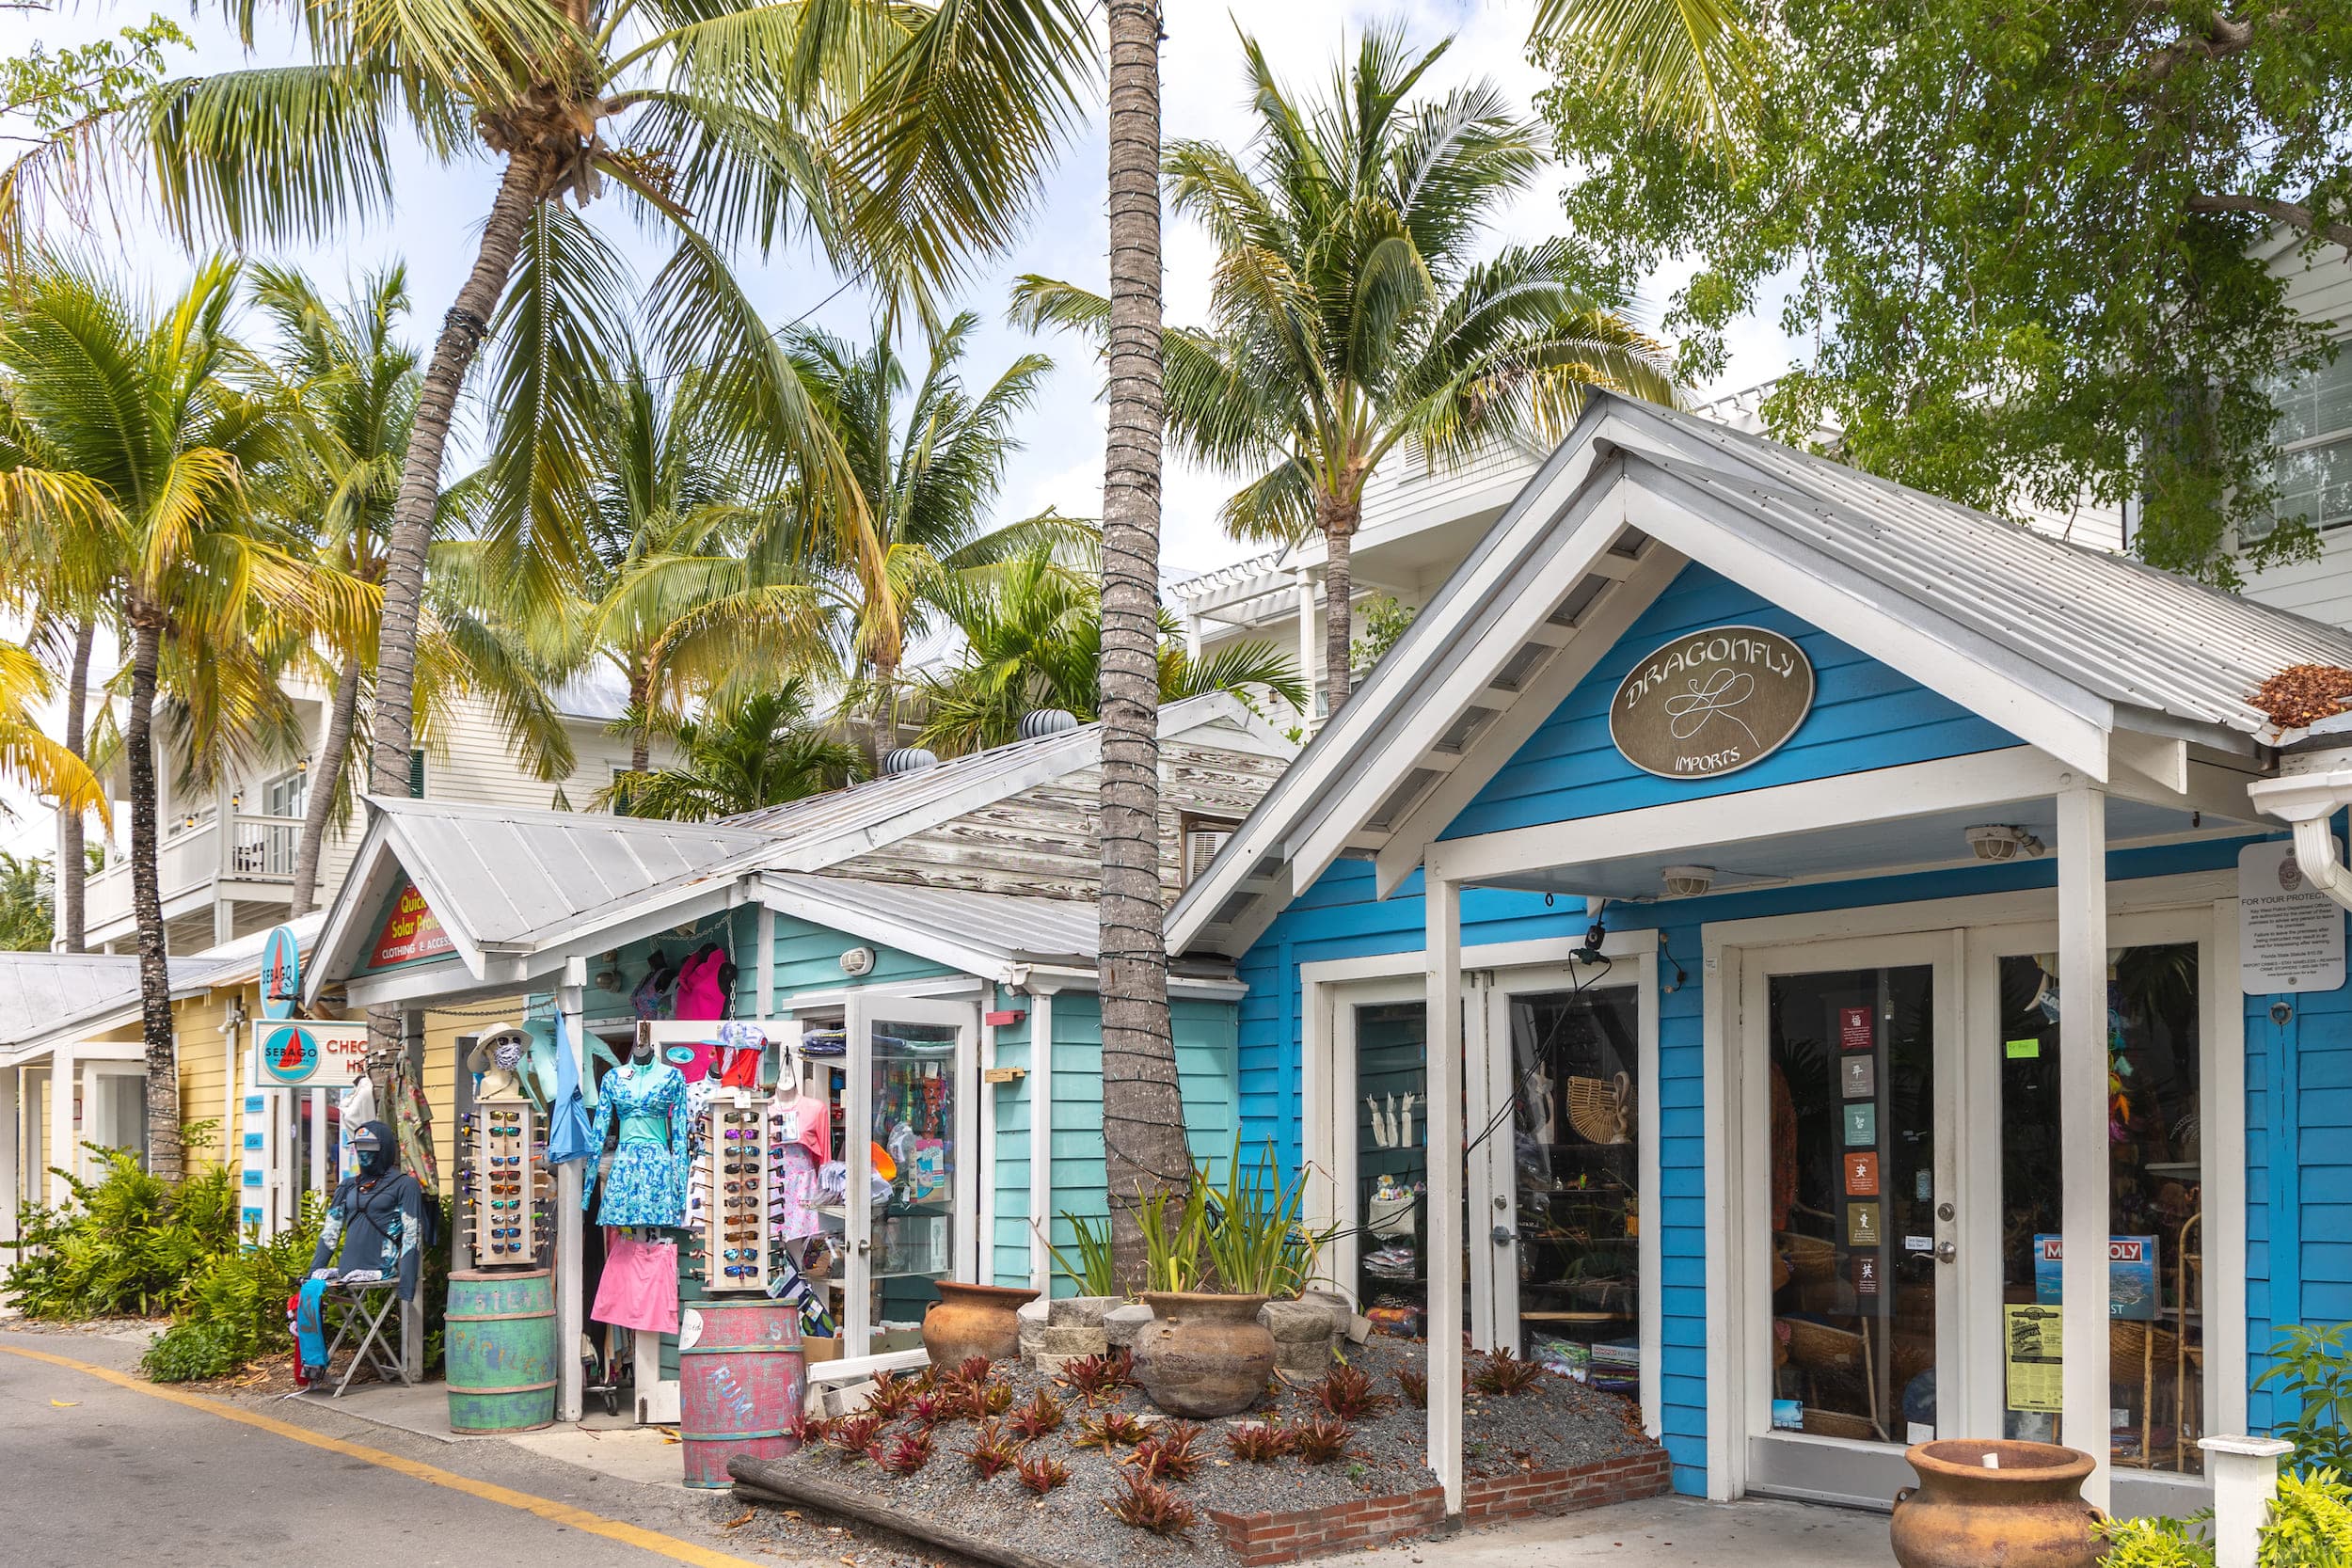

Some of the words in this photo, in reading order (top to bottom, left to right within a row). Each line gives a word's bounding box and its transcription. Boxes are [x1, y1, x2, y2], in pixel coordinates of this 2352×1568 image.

[1625, 638, 1795, 710] DRAGONFLY
[1675, 746, 1740, 772] IMPORTS
[2241, 897, 2259, 906] FOR
[2260, 895, 2284, 904] YOUR
[391, 918, 415, 939] Solar
[382, 943, 416, 959] CLOTHING
[262, 965, 292, 984] SEBAGO
[265, 1047, 317, 1057] SEBAGO
[2047, 1243, 2139, 1259] MOLY
[2109, 1304, 2124, 1314] ST
[710, 1364, 754, 1419] RUM
